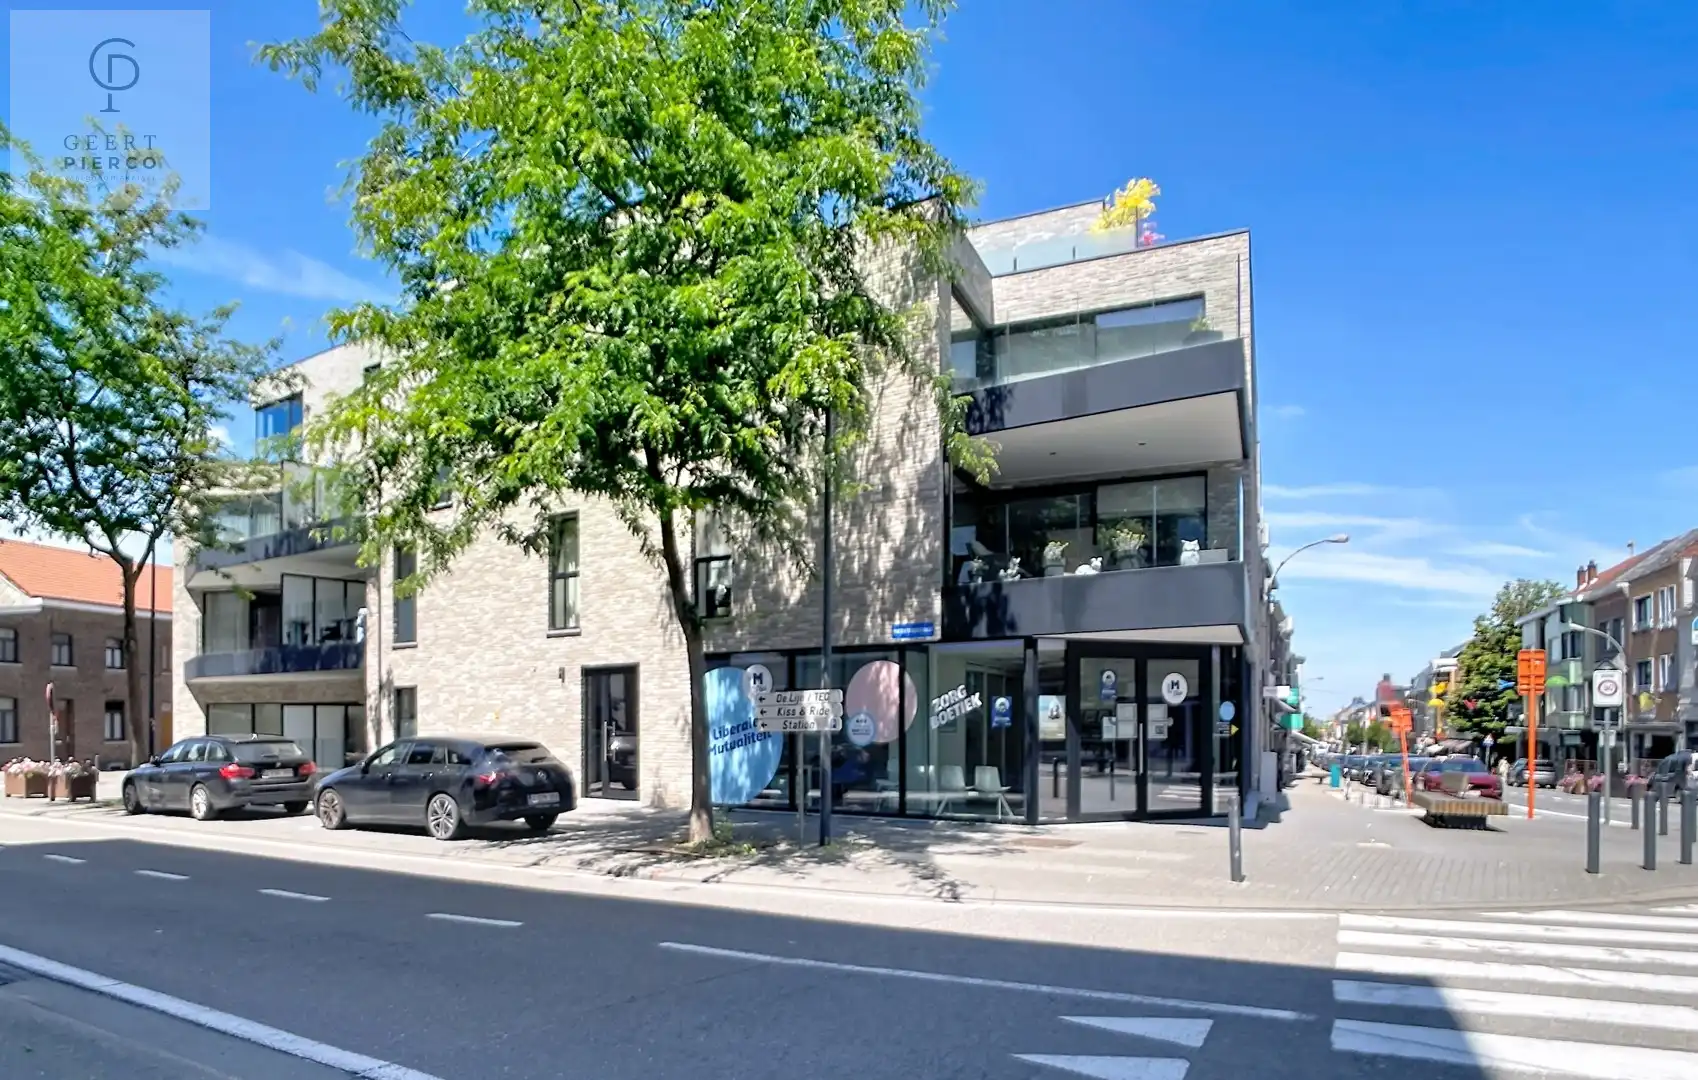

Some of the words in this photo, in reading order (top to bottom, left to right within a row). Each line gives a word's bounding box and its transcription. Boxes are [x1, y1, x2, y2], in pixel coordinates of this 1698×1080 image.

[931, 684, 968, 713] ZORG
[776, 706, 797, 716] Kiss
[799, 706, 806, 716] &
[809, 705, 830, 716] Ride
[930, 691, 983, 730] BOETIEK
[782, 719, 816, 730] Station
